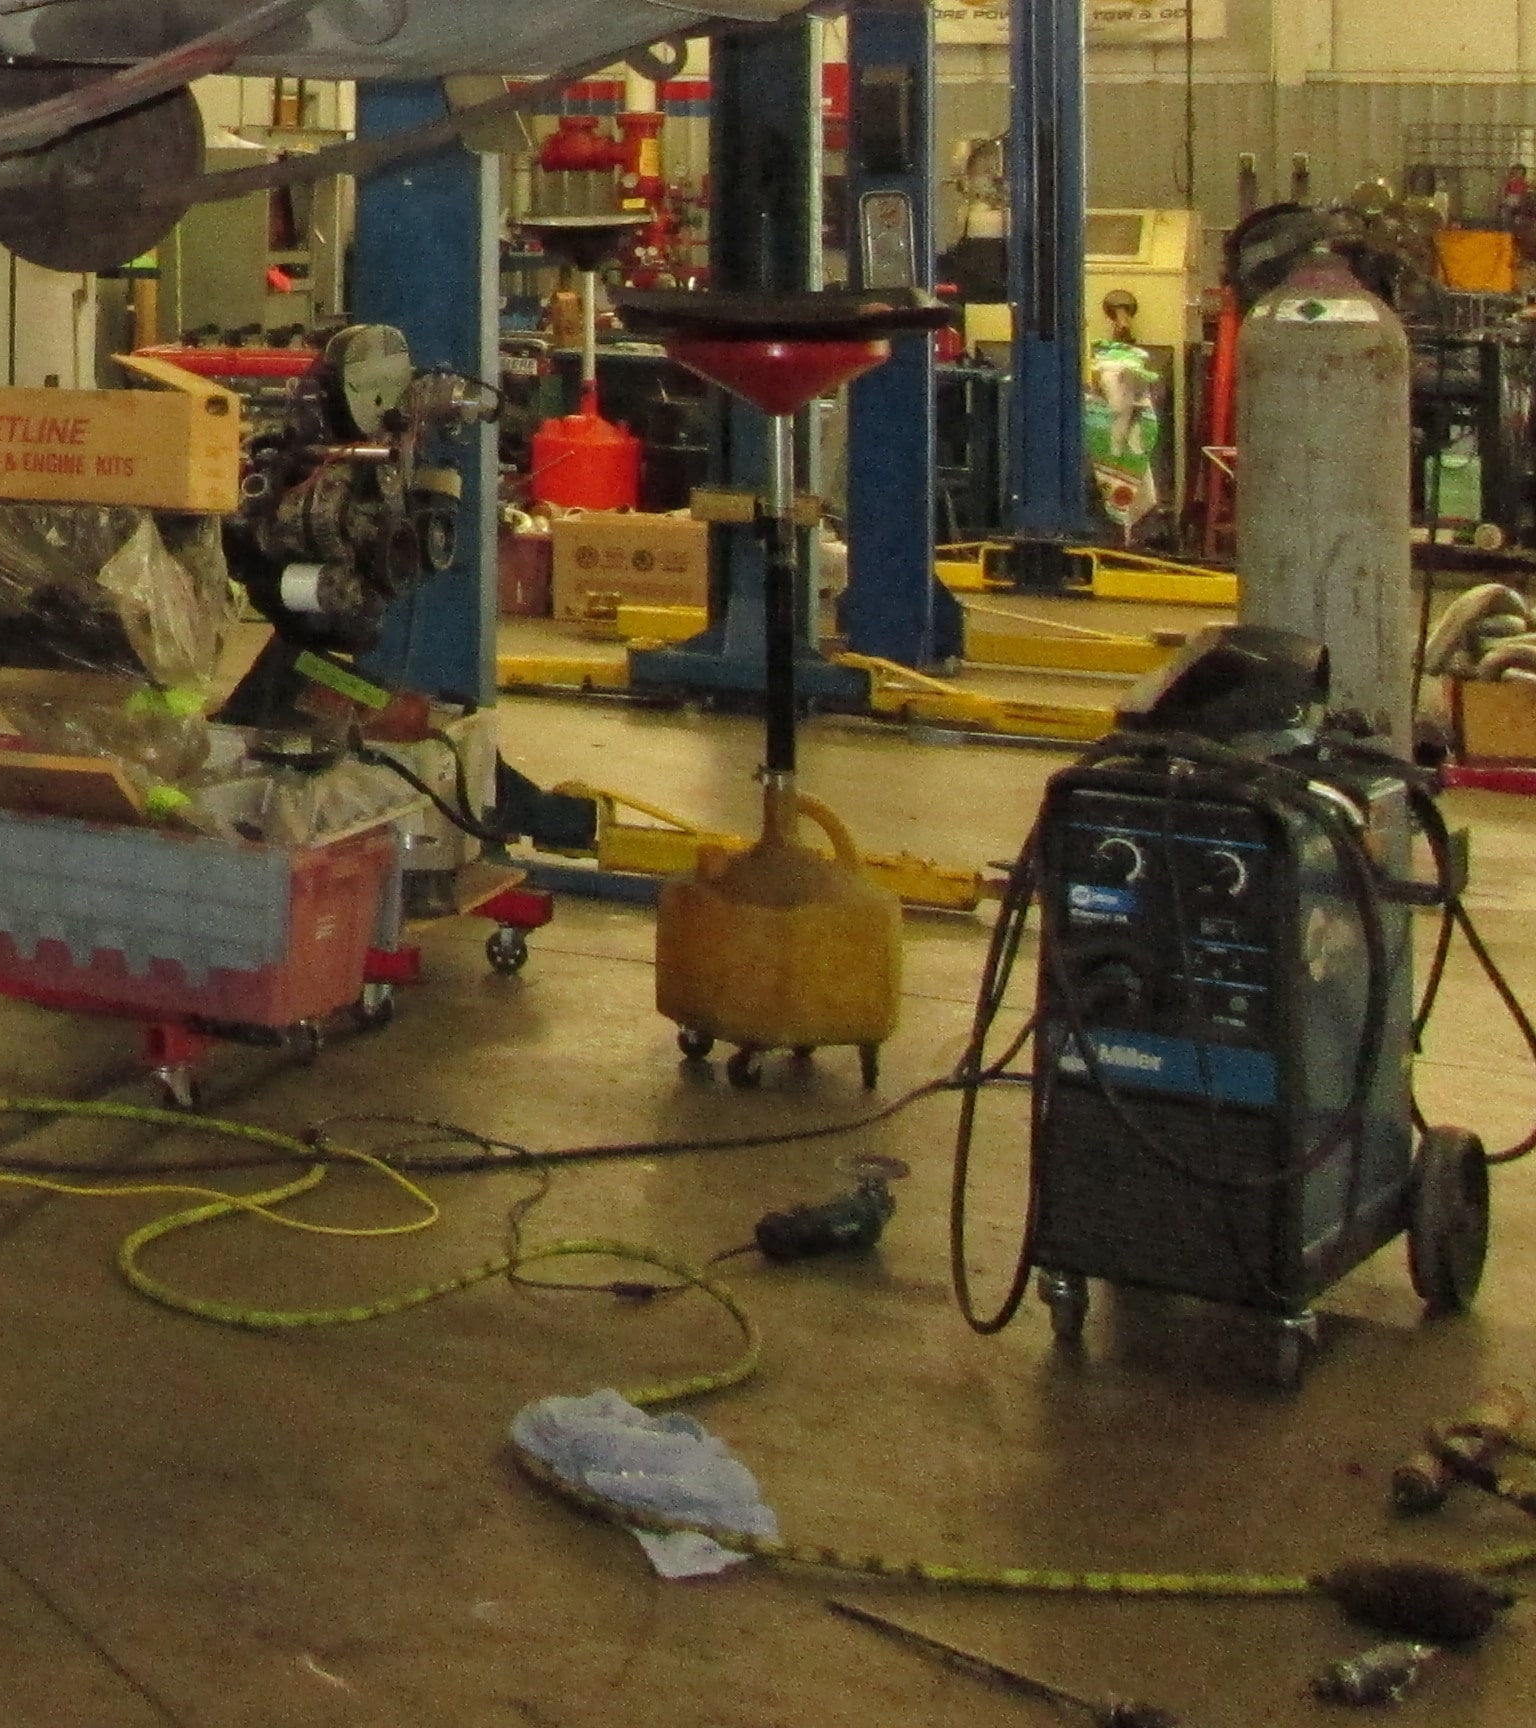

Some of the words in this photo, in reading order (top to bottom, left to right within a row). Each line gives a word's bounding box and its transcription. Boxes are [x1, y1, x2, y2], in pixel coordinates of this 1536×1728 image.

[933, 9, 966, 20] ORE
[5, 452, 18, 471] &
[23, 452, 85, 475] ENGINE
[95, 454, 135, 477] KITS
